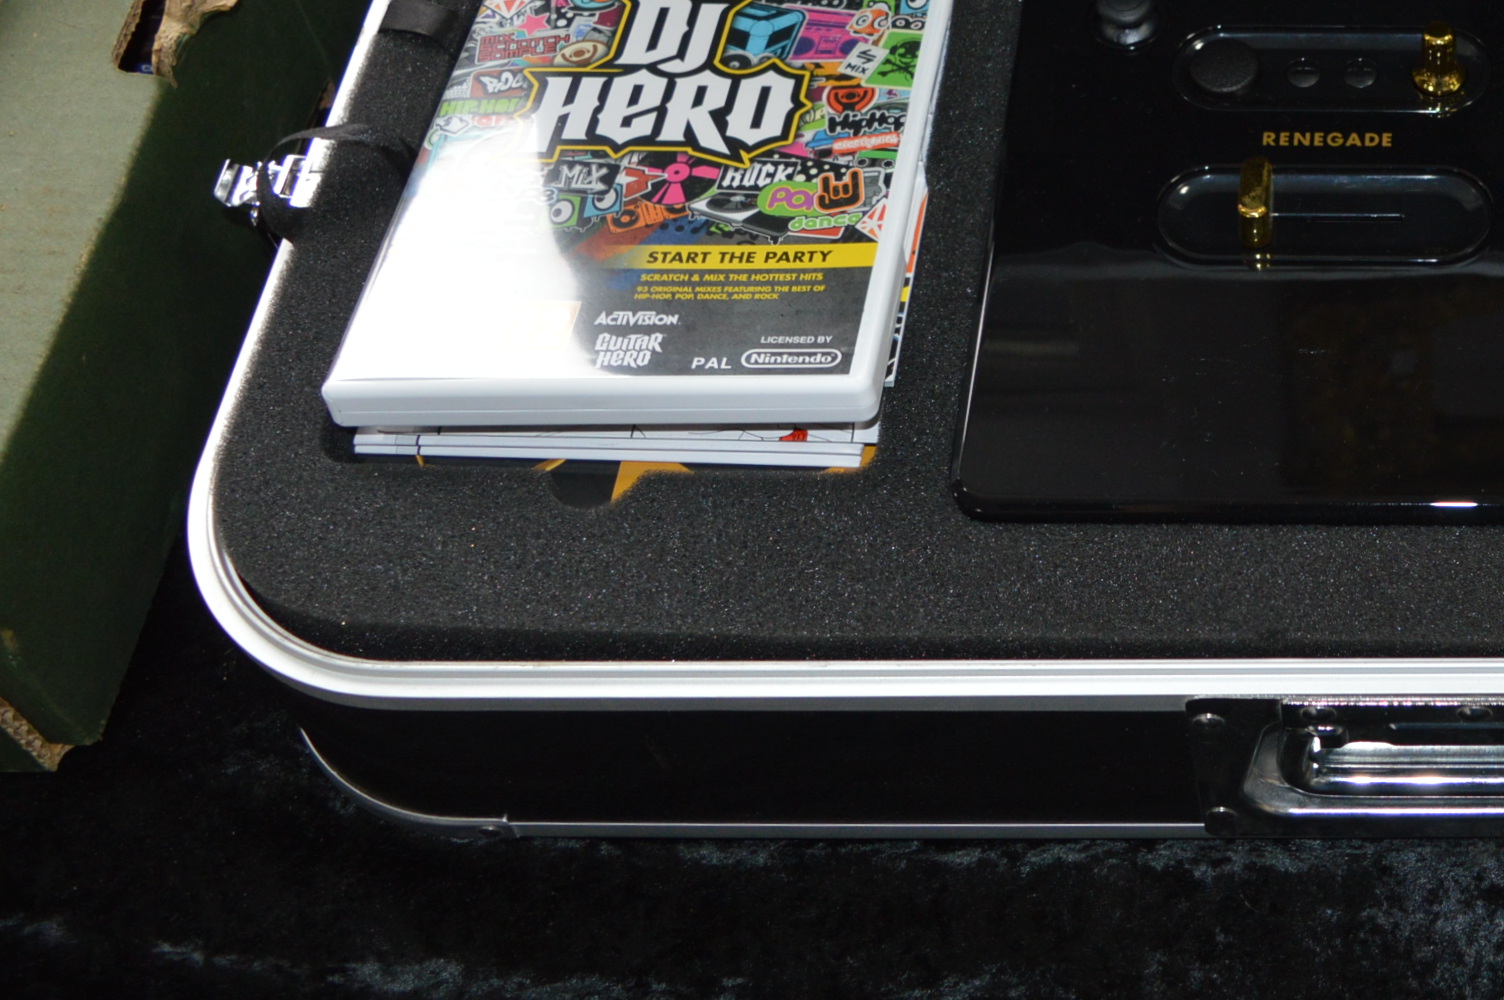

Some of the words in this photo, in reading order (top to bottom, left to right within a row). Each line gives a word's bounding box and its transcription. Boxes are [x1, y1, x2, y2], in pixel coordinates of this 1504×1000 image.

[845, 62, 869, 75] MIX
[1262, 131, 1393, 148] RENEGADE
[646, 251, 711, 264] START
[718, 251, 757, 263] THE
[764, 250, 833, 263] PARTY
[640, 273, 689, 281] SCRATCH
[691, 273, 700, 281] &
[703, 273, 725, 281] MIX
[729, 273, 749, 281] THE
[751, 273, 798, 281] HOTTEST
[800, 272, 824, 281] HITS
[695, 285, 722, 293] MIXES
[724, 285, 772, 293] FEATURING
[774, 285, 790, 293] THE
[594, 311, 679, 327] ACTIVISION
[760, 335, 815, 344] LICENSED
[817, 335, 833, 343] BY
[691, 357, 732, 369] PAL
[750, 353, 832, 365] Nintendo
